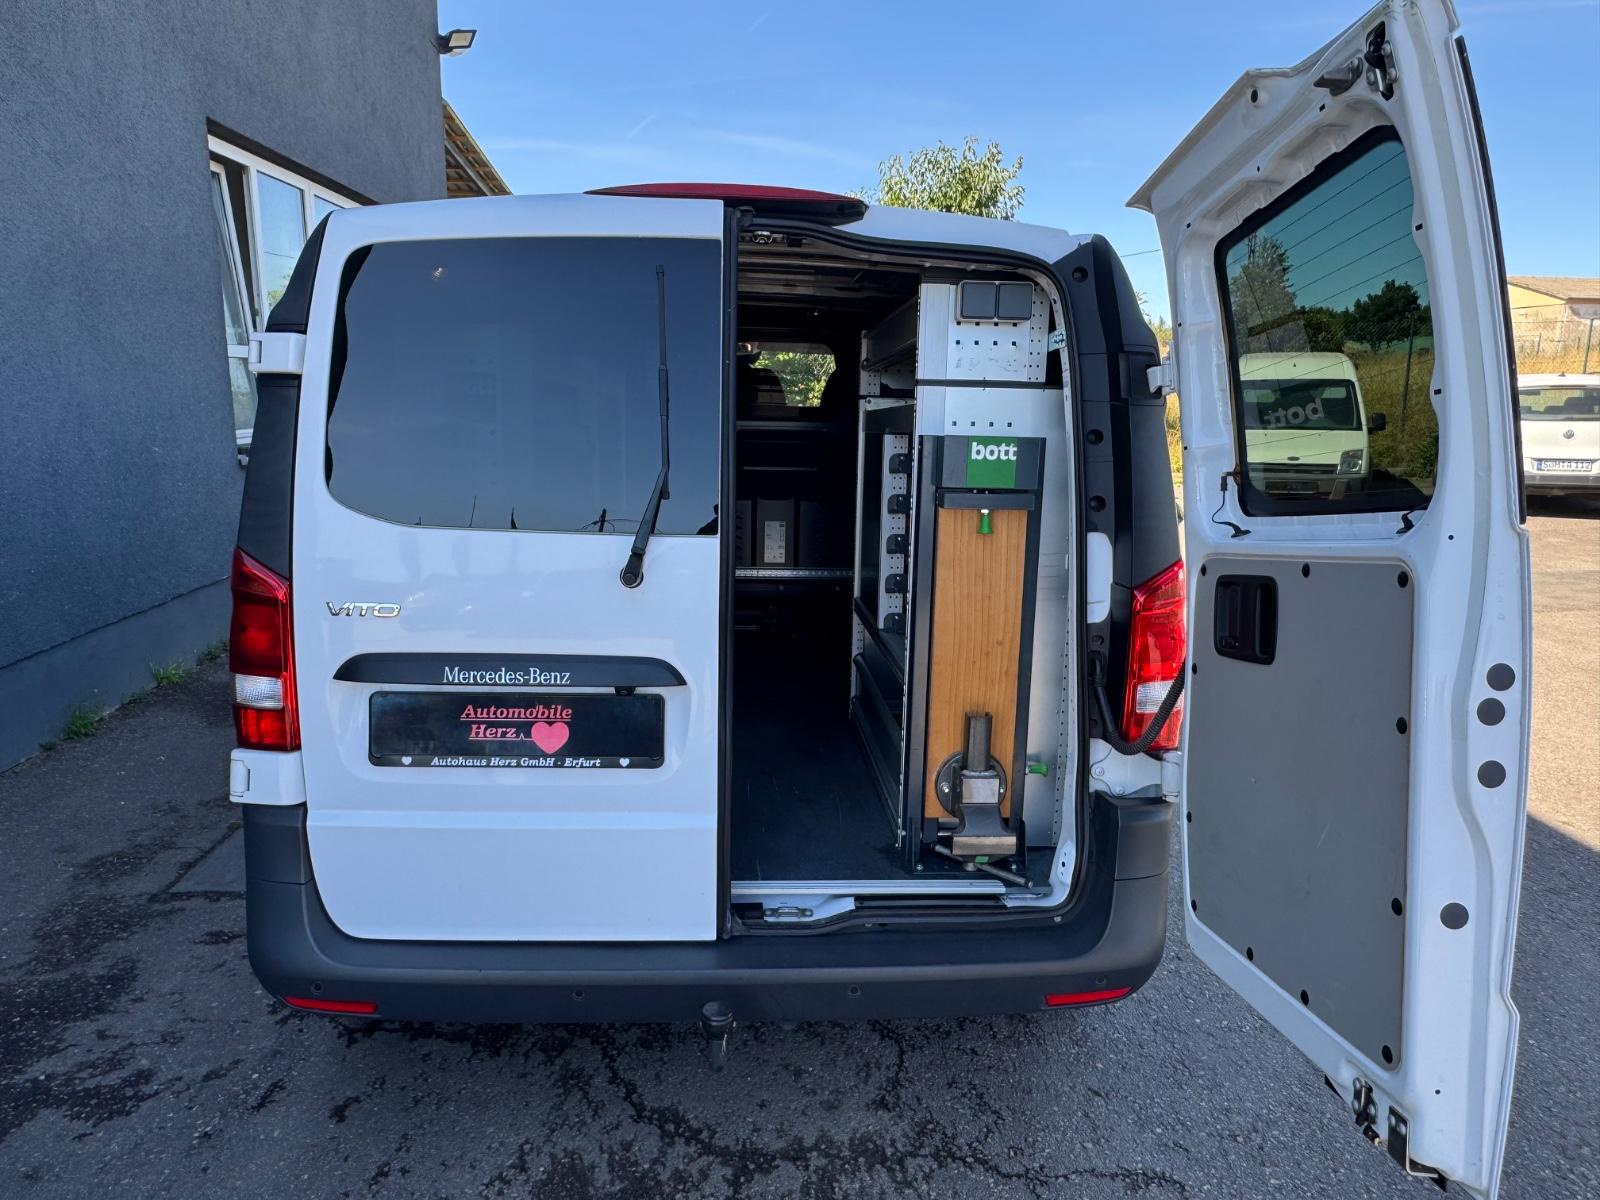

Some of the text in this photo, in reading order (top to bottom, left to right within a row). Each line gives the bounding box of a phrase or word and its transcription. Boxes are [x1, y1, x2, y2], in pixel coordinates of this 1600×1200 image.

[971, 441, 1017, 461] bott
[326, 601, 402, 617] VITO
[443, 666, 571, 685] Mercedes-Benz
[460, 704, 573, 719] Automobile
[469, 724, 517, 738] Herz
[431, 756, 487, 766] Autohaus
[489, 757, 517, 766] Herz
[520, 757, 555, 767] GmbH
[564, 757, 601, 768] Erfurt
